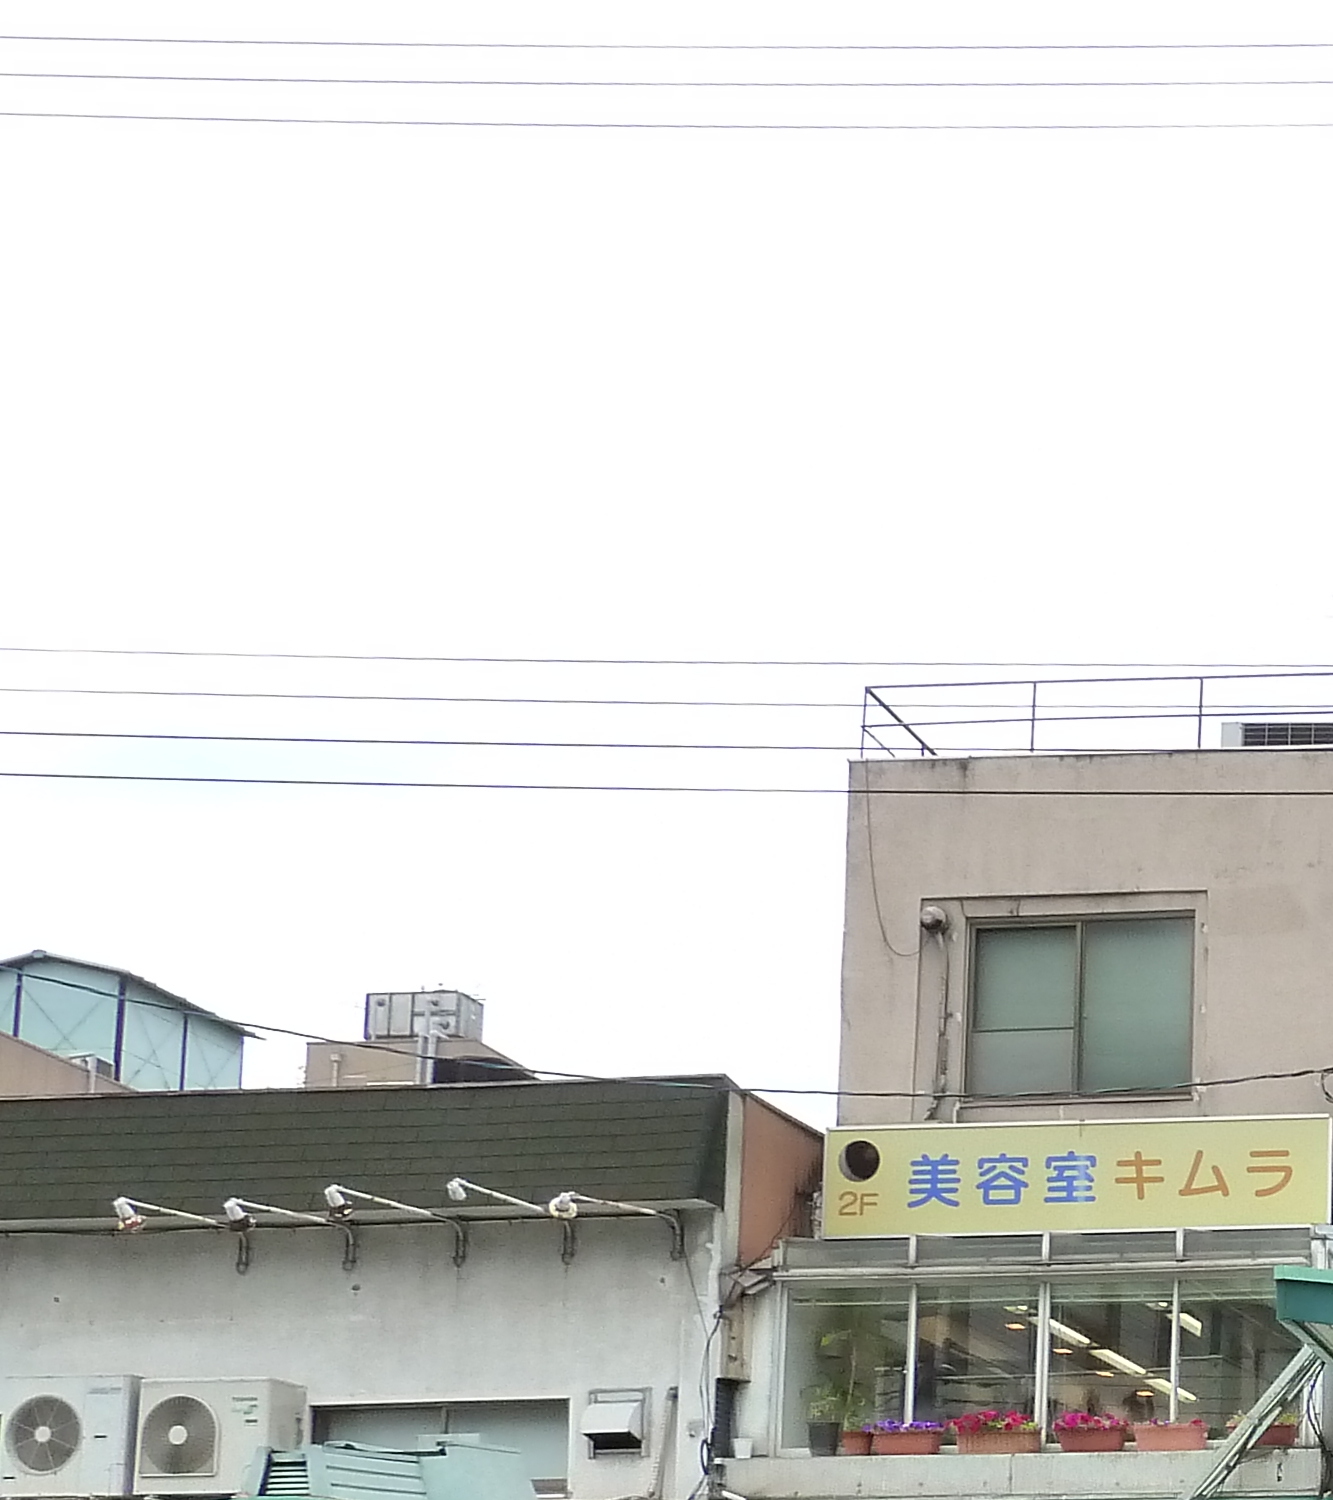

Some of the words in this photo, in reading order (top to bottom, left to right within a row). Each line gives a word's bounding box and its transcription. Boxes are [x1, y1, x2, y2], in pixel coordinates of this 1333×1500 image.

[907, 1149, 1293, 1209] 美容室キムラ
[838, 1192, 880, 1217] 2F
